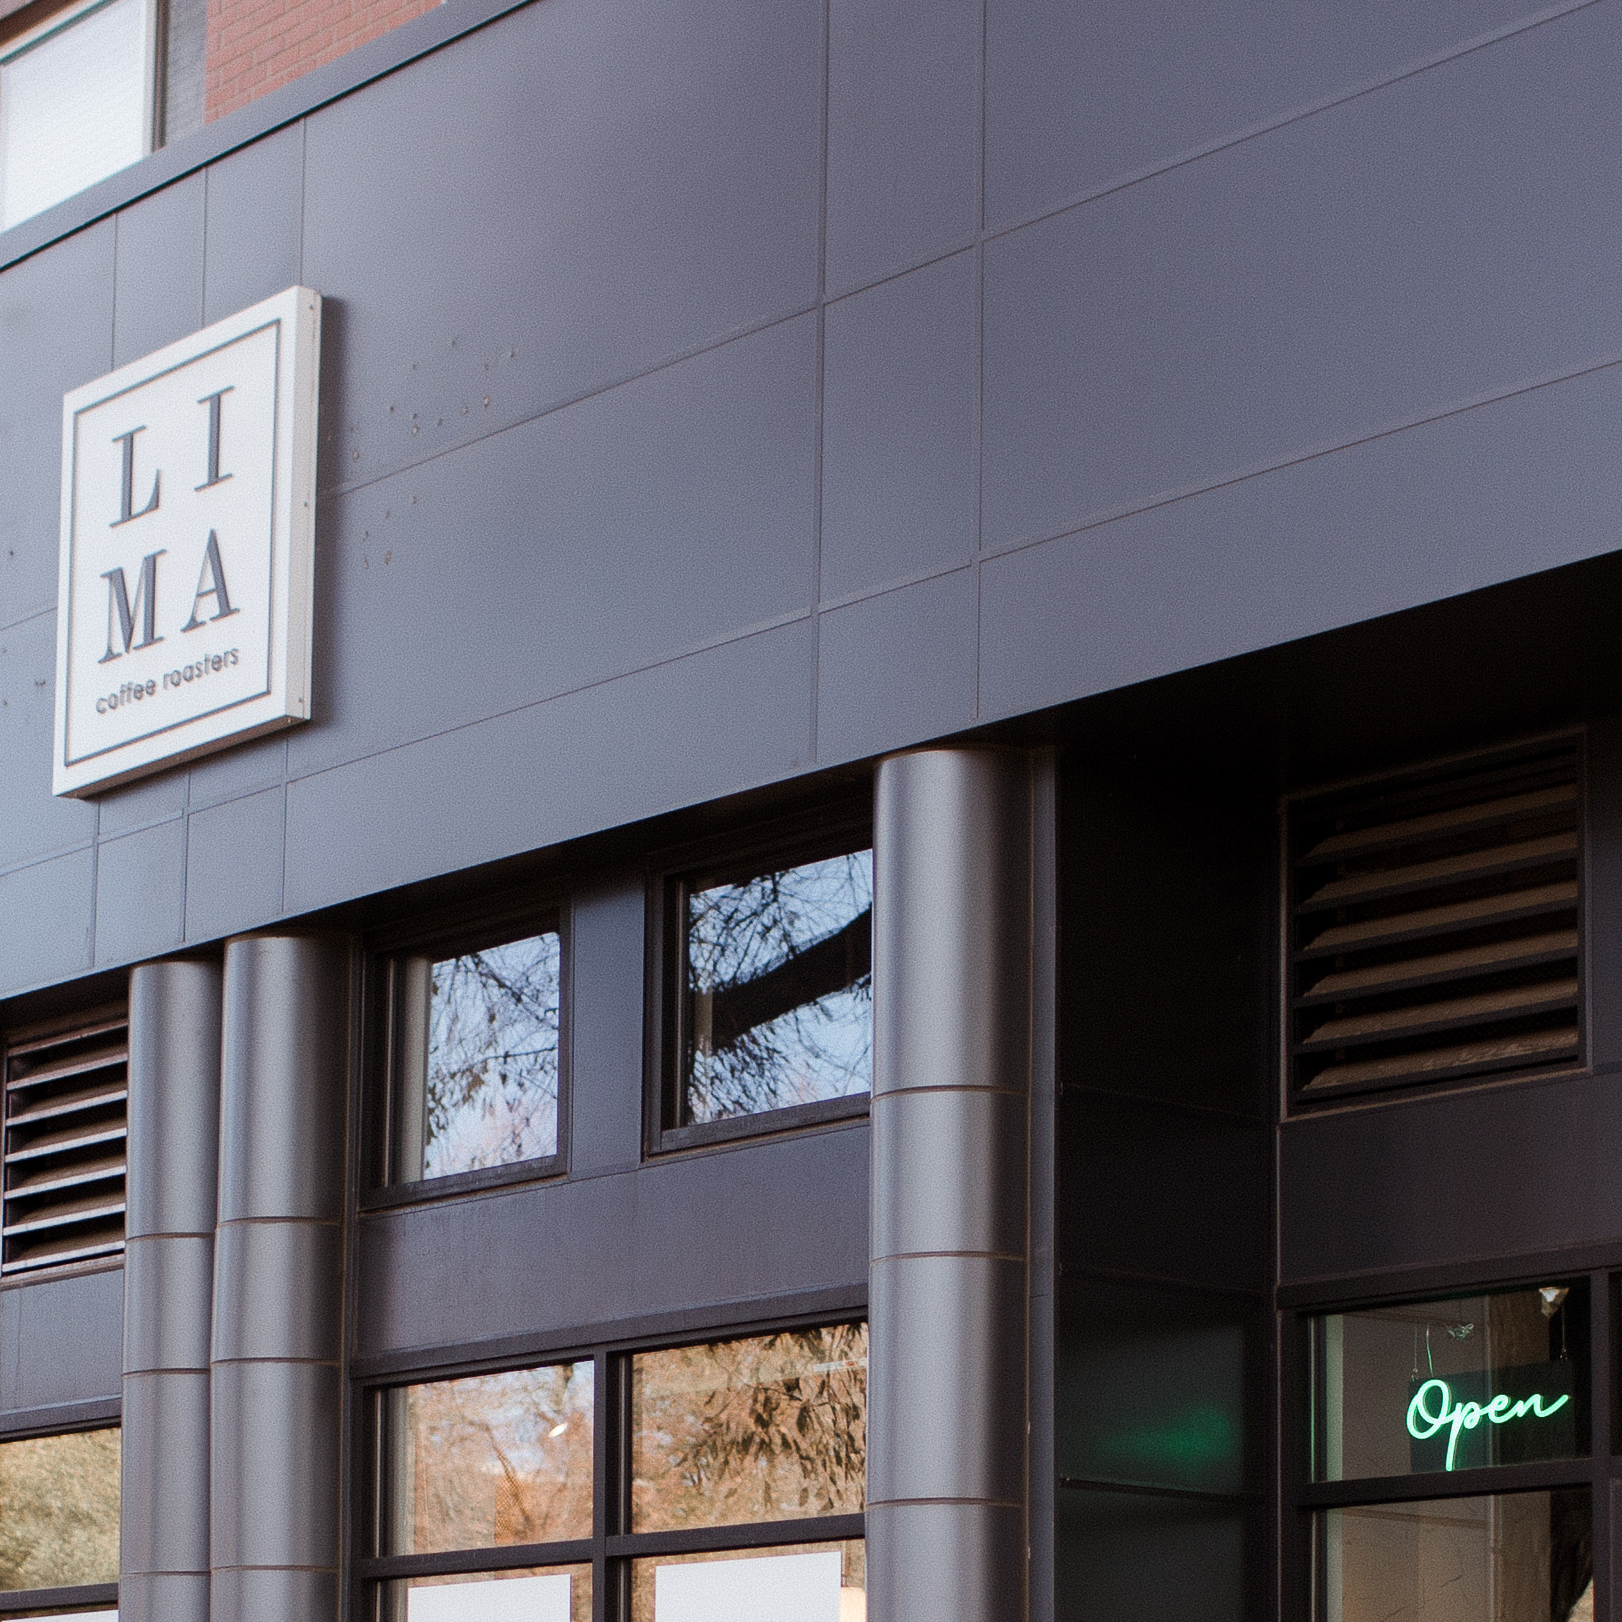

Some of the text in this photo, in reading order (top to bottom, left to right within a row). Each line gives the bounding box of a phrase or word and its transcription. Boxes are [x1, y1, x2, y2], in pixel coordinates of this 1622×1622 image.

[109, 385, 235, 528] LI
[97, 528, 240, 664] MA
[95, 647, 240, 715] coffee roasters
[1406, 1378, 1570, 1472] Open
